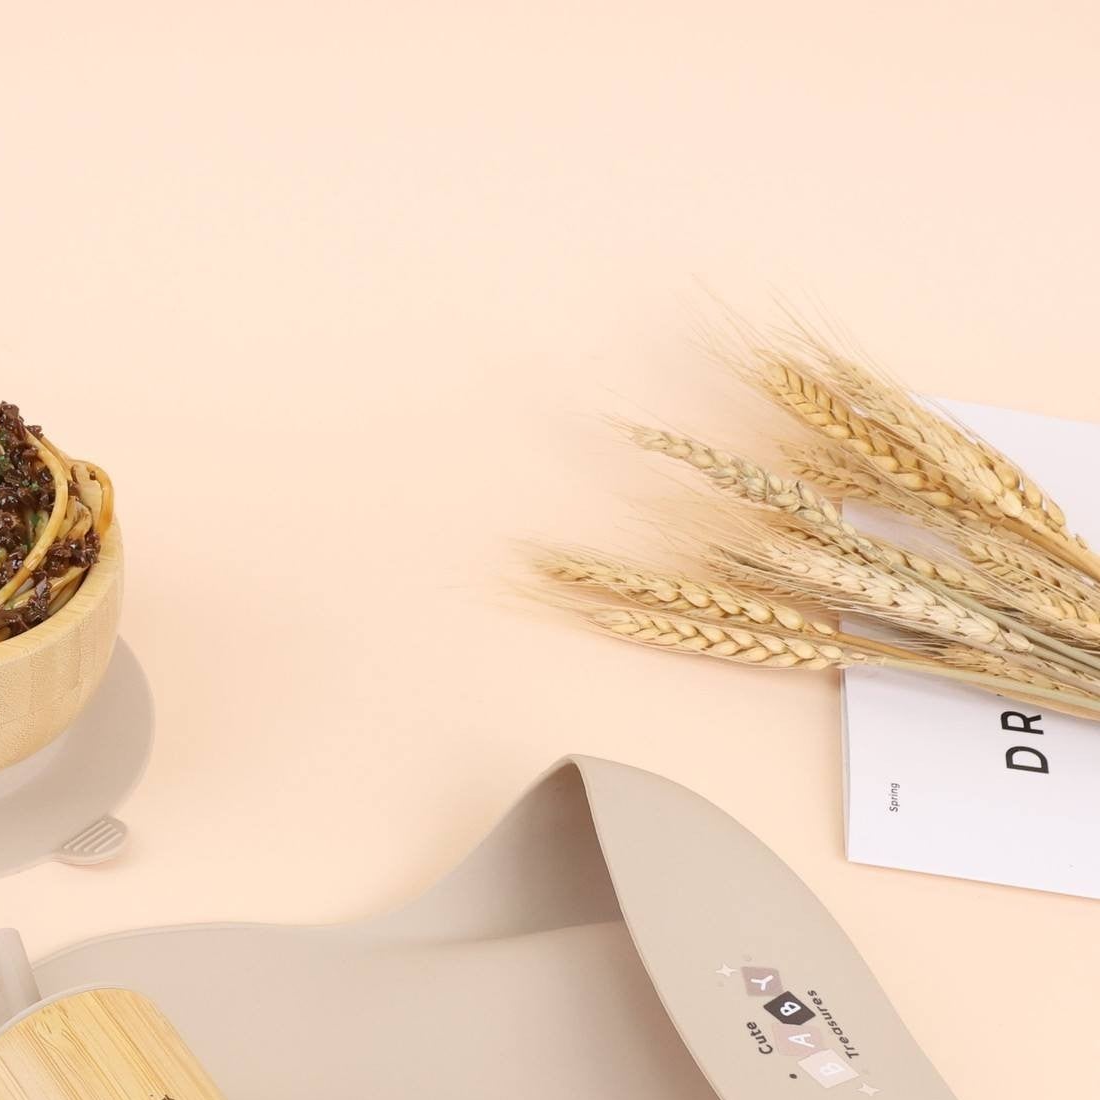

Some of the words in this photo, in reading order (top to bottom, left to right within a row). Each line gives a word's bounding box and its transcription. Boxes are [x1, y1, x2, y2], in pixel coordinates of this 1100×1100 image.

[999, 709, 1050, 775] DR
[888, 782, 901, 813] Spring
[746, 1021, 774, 1055] Cute
[749, 974, 847, 1077] BABY
[807, 989, 860, 1060] Treasures
